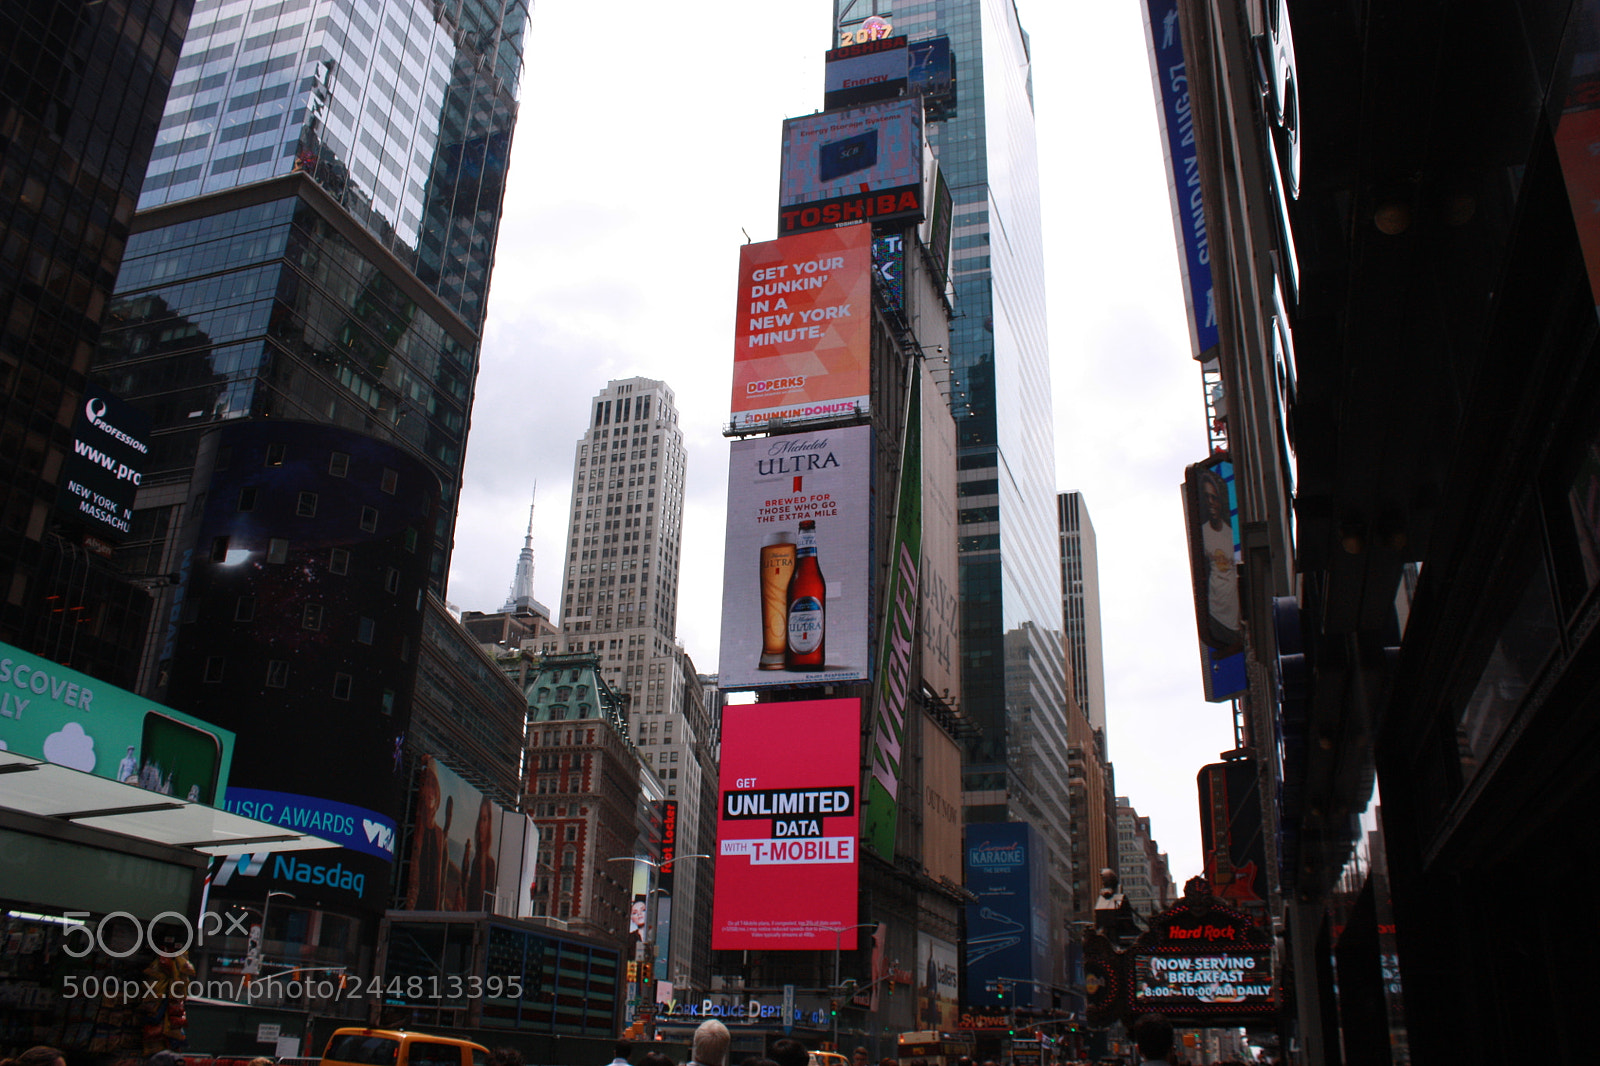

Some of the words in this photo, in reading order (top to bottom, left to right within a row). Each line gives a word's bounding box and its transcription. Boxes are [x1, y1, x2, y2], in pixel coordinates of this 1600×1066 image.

[841, 24, 893, 47] 2017
[828, 36, 905, 60] TOSHIBA
[842, 74, 889, 89] Energy
[800, 127, 829, 137] Energy
[830, 121, 864, 132] Storage
[865, 114, 901, 126] Systems
[781, 190, 919, 230] TOSHIBA
[834, 218, 864, 229] TOSHIBA
[752, 265, 788, 283] GET
[793, 256, 844, 275] YOUR
[751, 275, 828, 299] DUNKIN'
[750, 300, 769, 315] IN
[774, 297, 788, 311] A
[750, 313, 794, 331] NEW
[799, 304, 851, 323] YORK
[748, 325, 825, 348] MINUTE.
[768, 438, 829, 456] Michelob
[758, 452, 840, 476] ULTRA
[68, 480, 92, 499] NEW
[93, 492, 118, 514] YORK
[759, 505, 790, 515] THOSE
[794, 502, 818, 512] WHO
[822, 500, 836, 509] GO
[765, 496, 807, 507] BREWED
[810, 493, 831, 501] FOR
[757, 514, 776, 524] THE
[778, 511, 811, 522] EXTRA
[814, 508, 838, 518] MILE
[923, 607, 951, 675] 4:44
[872, 540, 918, 802] WICKED
[736, 778, 757, 789] GET
[727, 791, 850, 816] UNLIMITED
[278, 805, 355, 836] AWARDS
[662, 804, 677, 844] Locker
[775, 819, 820, 837] DATA
[724, 842, 748, 852] WITH
[752, 840, 850, 861] T-MOBILE
[972, 850, 1022, 864] KARAOKE
[273, 855, 365, 899] Nasdaq
[1169, 925, 1202, 939] Hard
[1203, 924, 1236, 941] Rock
[937, 960, 957, 988] ballers
[1156, 957, 1190, 970] NOW
[1194, 957, 1256, 970] SERVING
[1168, 971, 1244, 983] BREAKFAST
[1144, 986, 1169, 997] 8:00
[1181, 986, 1213, 997] 10:00
[1215, 986, 1234, 996] AM
[1237, 985, 1271, 996] DAILY
[702, 999, 745, 1017] POLICE
